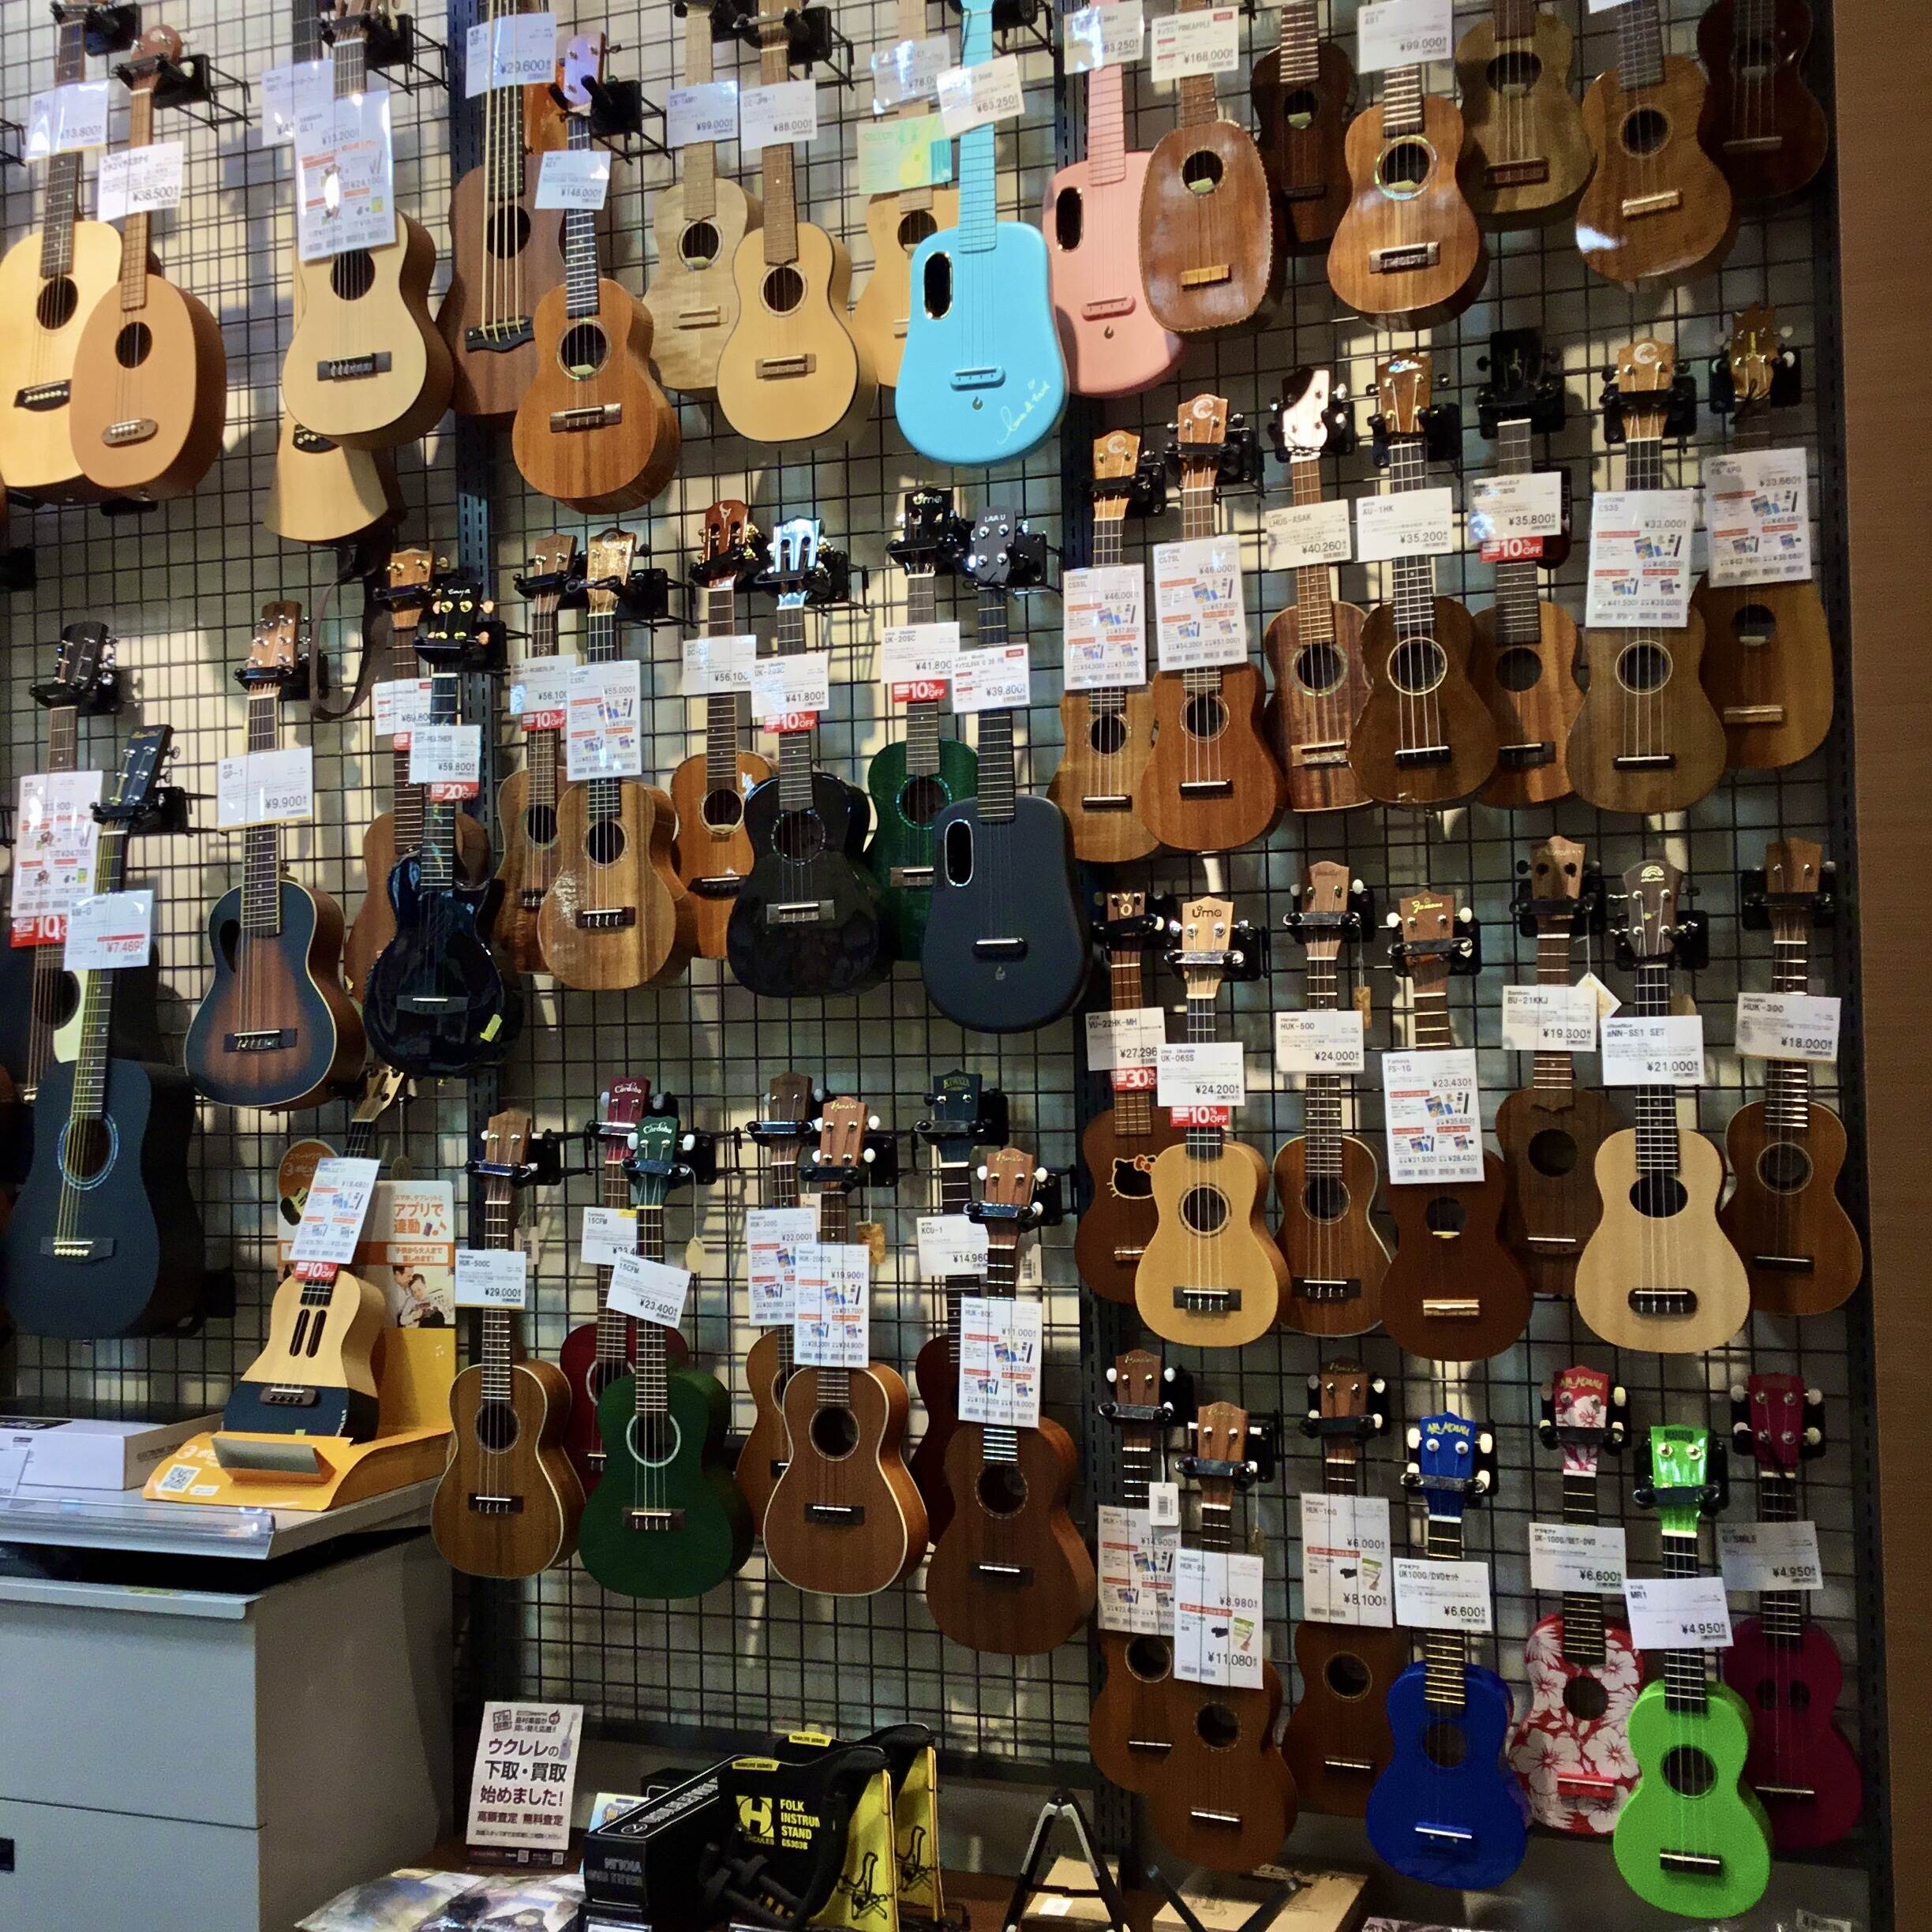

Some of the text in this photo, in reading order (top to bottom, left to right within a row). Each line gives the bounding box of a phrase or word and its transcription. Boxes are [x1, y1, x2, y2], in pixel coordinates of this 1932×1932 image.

[1103, 38, 1135, 53] 63,250
[1509, 514, 1550, 526] ¥35,800
[1400, 531, 1443, 545] ¥35,200
[1302, 541, 1341, 555] ¥40,260
[1522, 545, 1542, 556] OFF
[786, 691, 822, 703] ¥41,800
[928, 688, 945, 697] OFF
[799, 719, 815, 728] OFF
[438, 762, 473, 772] ¥59,800
[265, 795, 302, 809] ¥9,900
[1543, 1028, 1586, 1039] ¥19,300
[1781, 1036, 1829, 1050] ¥18,000
[1120, 1046, 1158, 1058] ¥27,296
[1161, 1054, 1195, 1063] UK-06SS
[1315, 1051, 1355, 1061] ¥24,000
[1647, 1061, 1694, 1072] ¥21,000
[1195, 1084, 1235, 1095] ¥24,200
[1432, 1078, 1469, 1088] ¥23,430
[1210, 1114, 1227, 1124] OFF
[395, 1202, 444, 1217] アプリで
[395, 1219, 421, 1234] 連動
[485, 1288, 518, 1297] ¥29,000
[640, 1297, 676, 1316] ¥23,400
[1346, 1537, 1381, 1549] ¥6,000
[1580, 1570, 1616, 1582] ¥6,600
[1773, 1565, 1810, 1578] ¥4,950
[1219, 1597, 1254, 1609] ¥8,980
[1343, 1593, 1383, 1606] ¥8,100
[1443, 1605, 1481, 1618] ¥6,600
[1681, 1622, 1721, 1635] ¥4,950
[1208, 1653, 1252, 1668] ¥11,080
[489, 1738, 559, 1757] ウクレレの
[484, 1760, 567, 1783] 下取・買取
[480, 1785, 564, 1807] 始めました!
[780, 1799, 805, 1812] FOLK
[477, 1810, 564, 1826] 高額査定 無料査定
[781, 1825, 813, 1840] STAND
